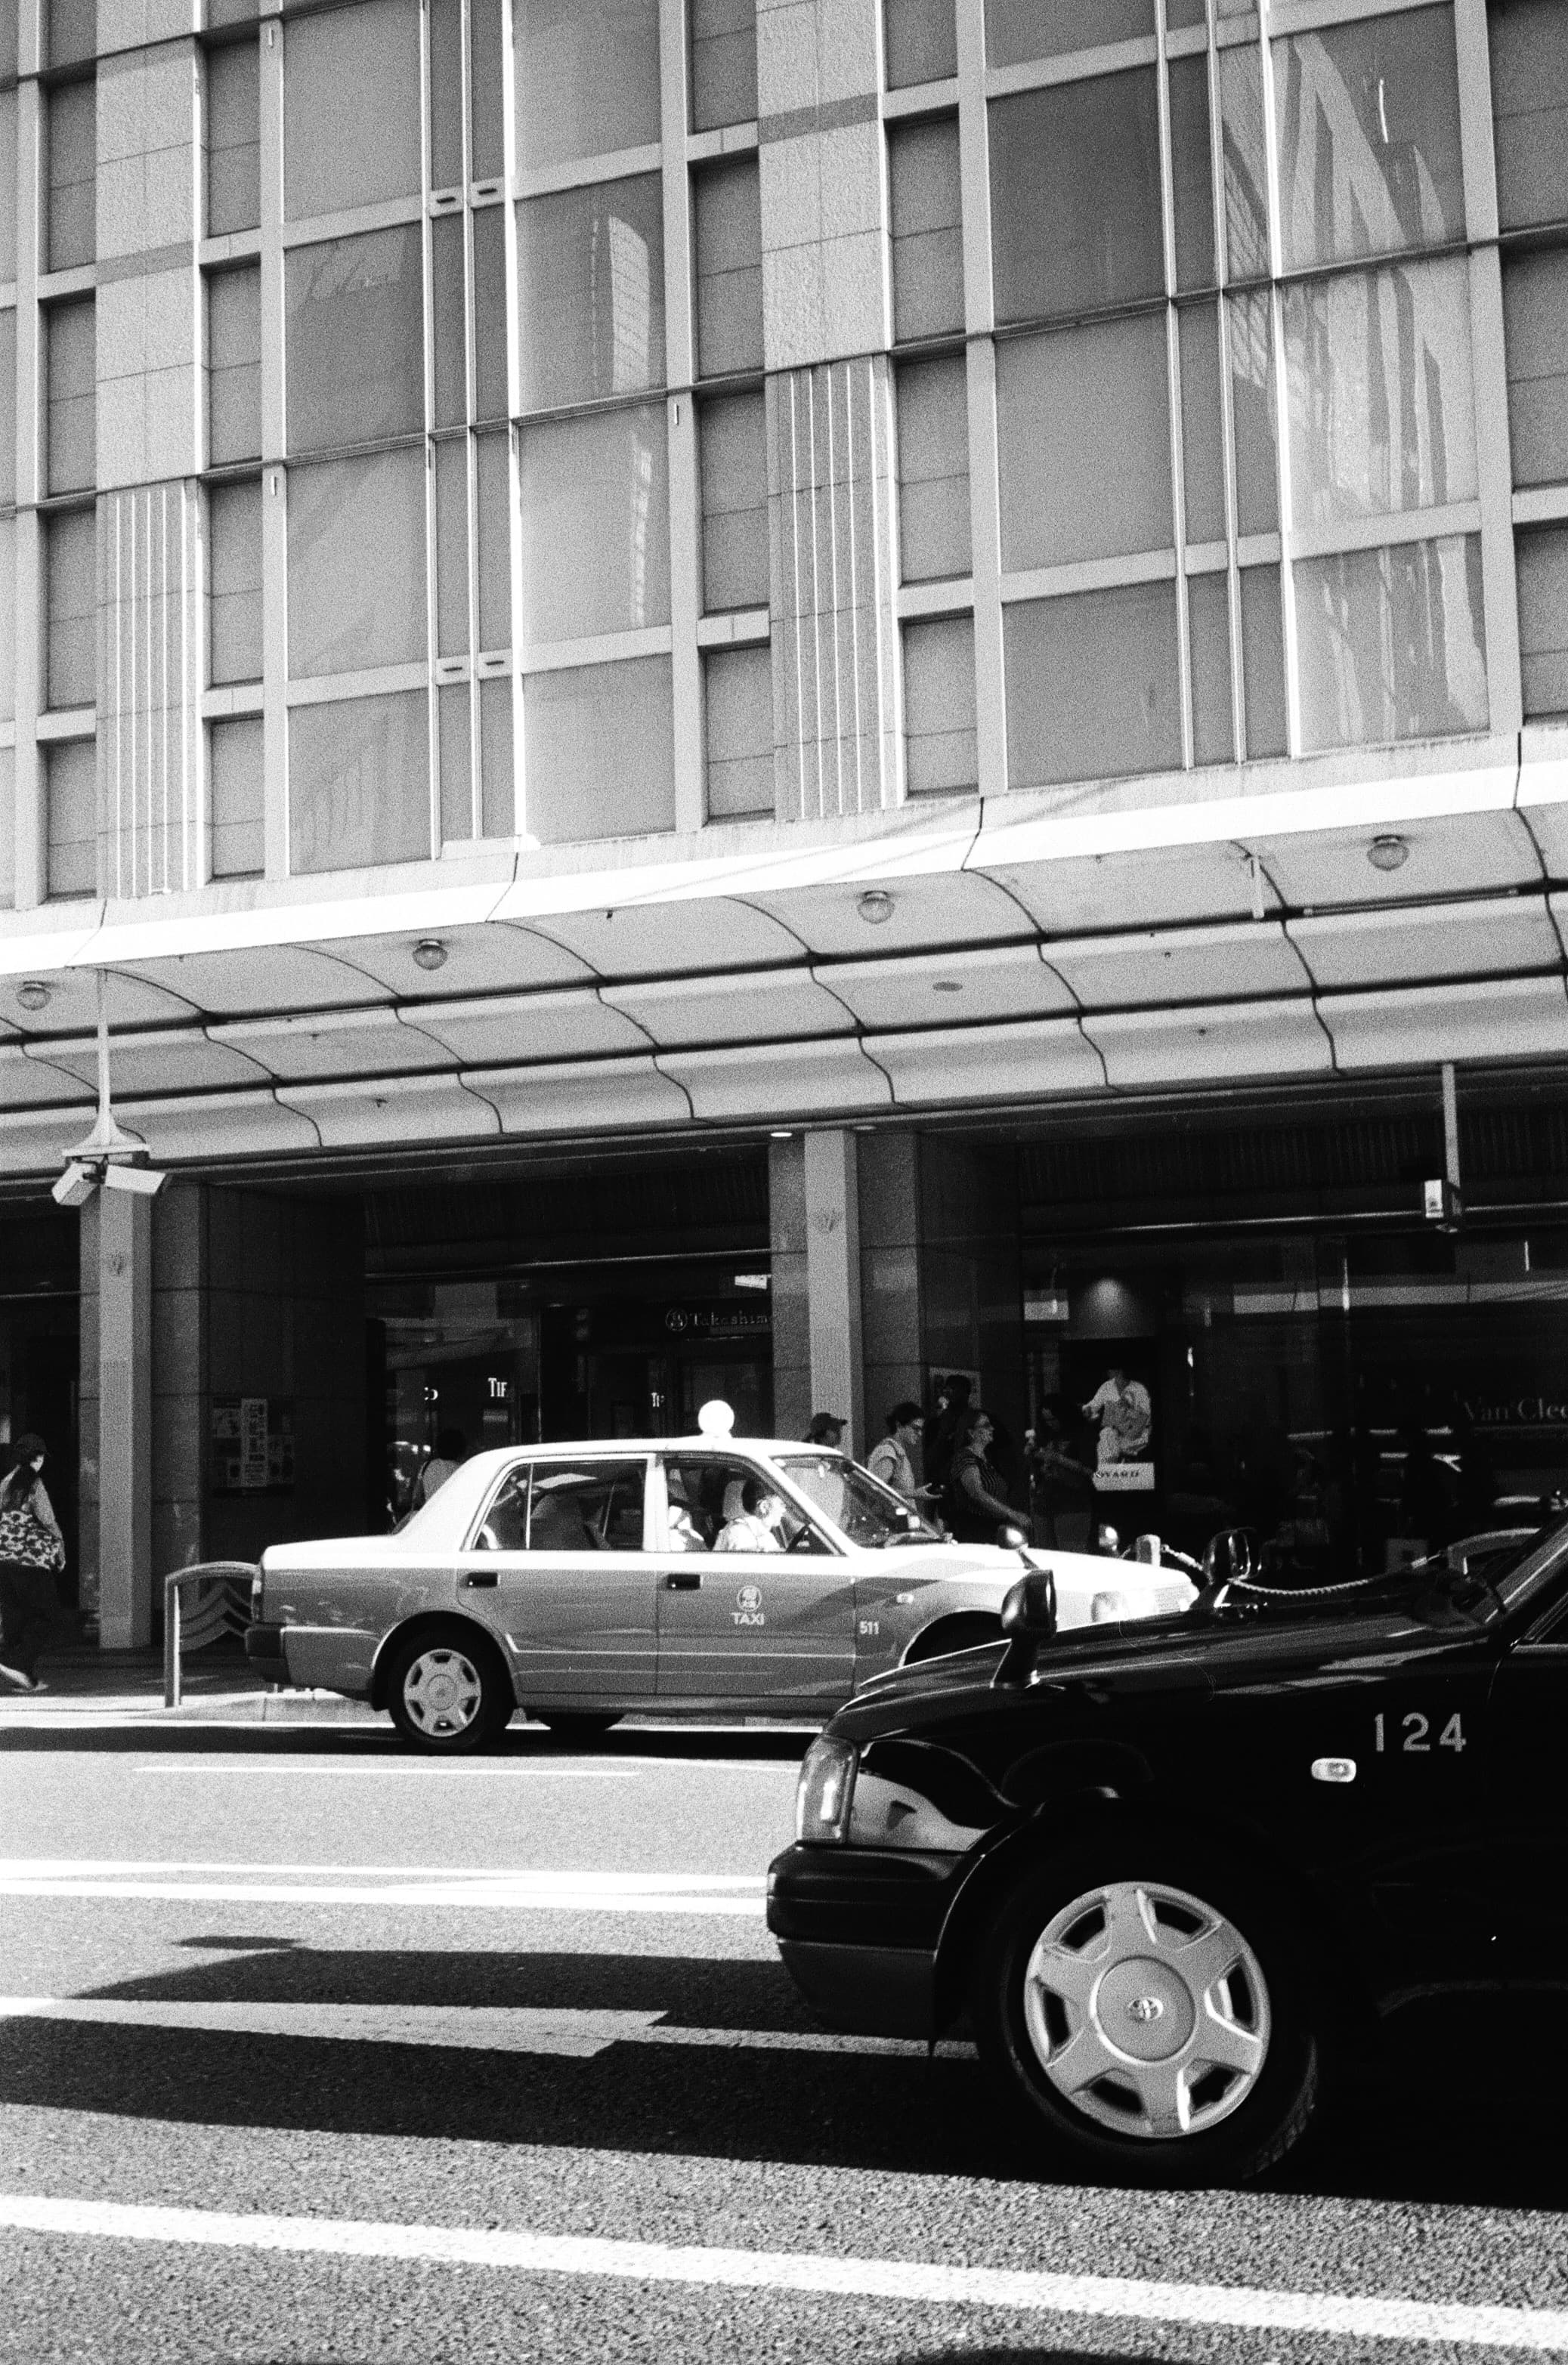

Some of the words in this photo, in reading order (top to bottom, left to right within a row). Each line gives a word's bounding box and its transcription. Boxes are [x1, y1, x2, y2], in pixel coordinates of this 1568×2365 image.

[688, 1310, 771, 1326] Takashim
[1463, 1399, 1510, 1420] Van
[730, 1612, 765, 1625] TAXI
[859, 1620, 880, 1634] 511
[1375, 1711, 1467, 1752] 124
